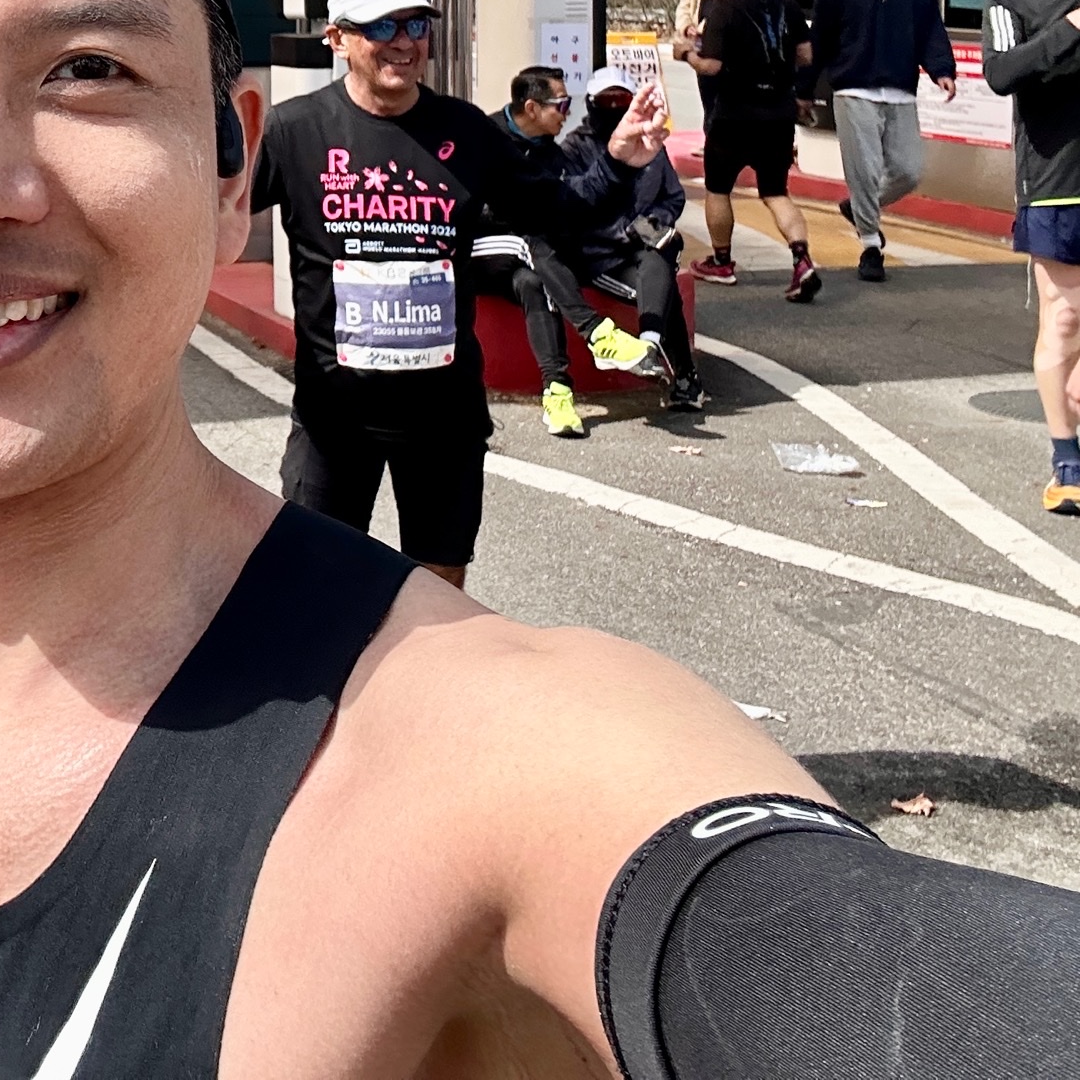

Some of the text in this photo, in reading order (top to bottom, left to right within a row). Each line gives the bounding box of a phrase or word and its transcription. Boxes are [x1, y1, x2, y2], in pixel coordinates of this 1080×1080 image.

[611, 48, 655, 61] 오토바이
[320, 173, 340, 183] RUN
[324, 182, 356, 191] HEART
[322, 193, 456, 223] CHARITY
[324, 221, 457, 237] TOKYO MARATHON 2024
[345, 299, 442, 325] B N.Lima
